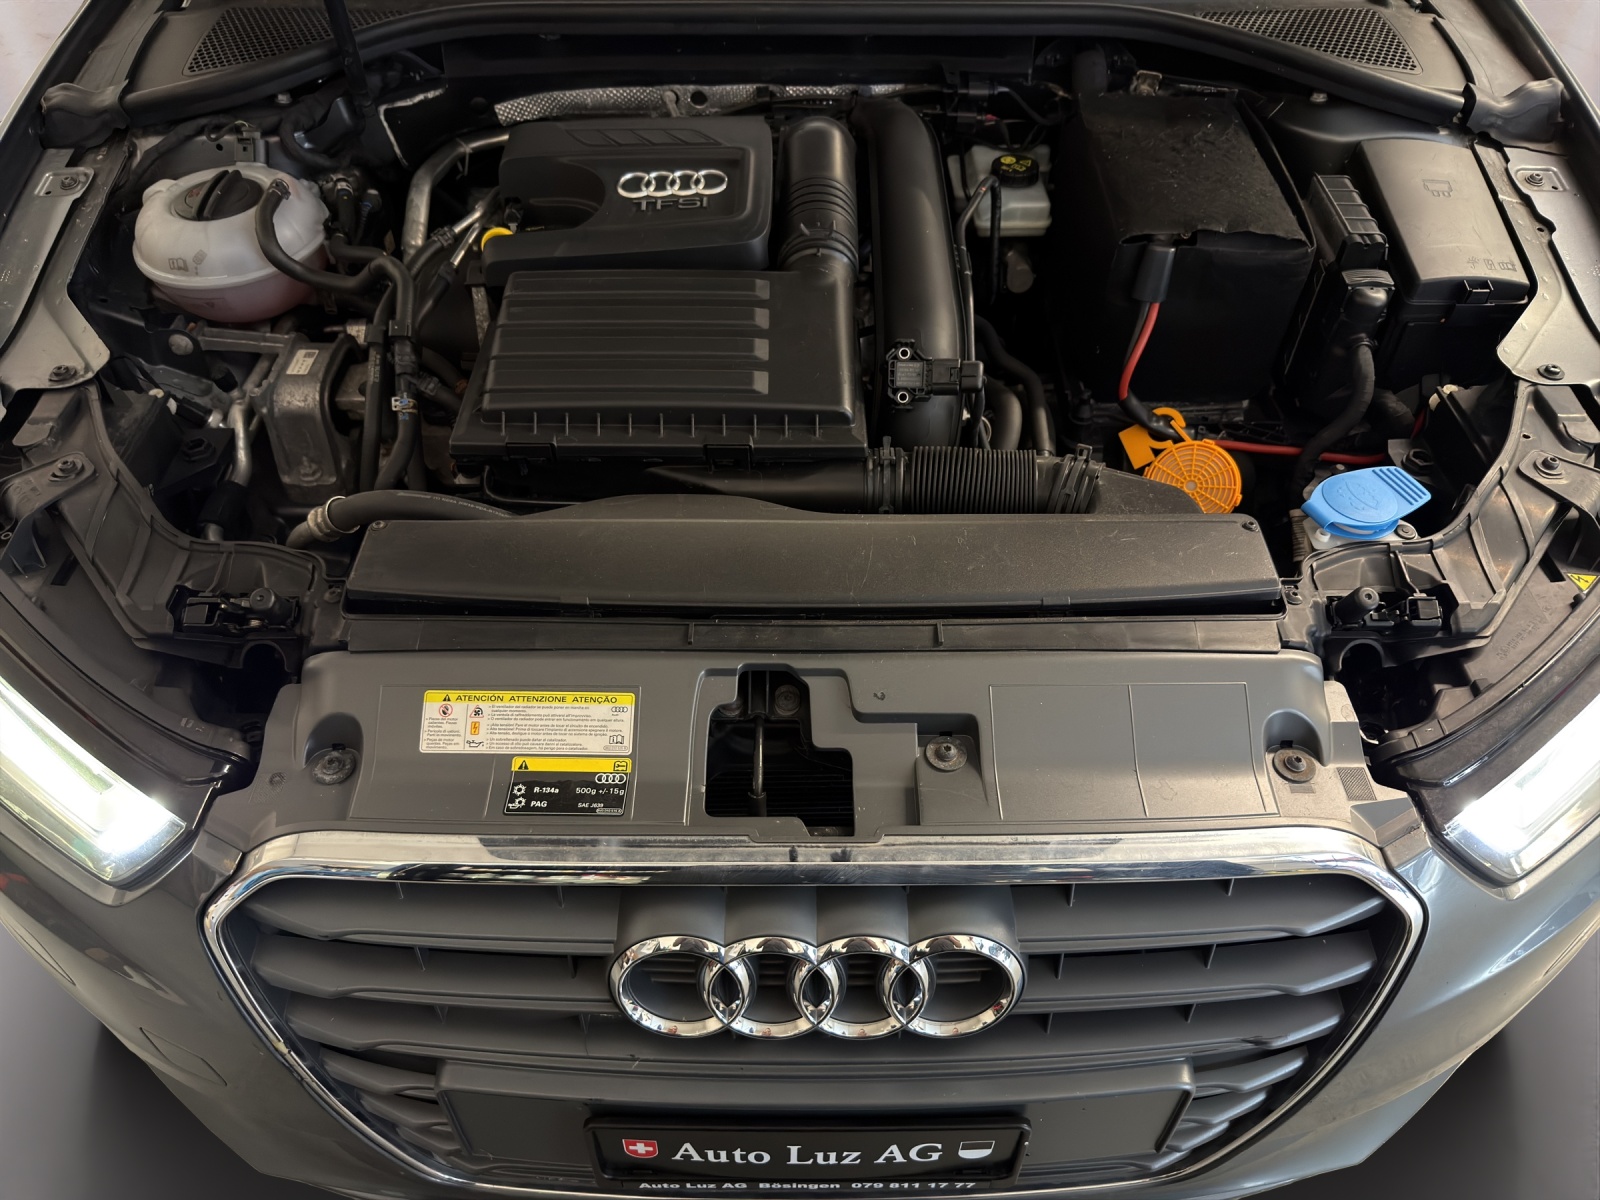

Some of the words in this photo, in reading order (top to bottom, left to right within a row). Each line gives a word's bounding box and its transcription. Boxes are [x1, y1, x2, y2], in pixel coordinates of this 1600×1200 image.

[632, 197, 708, 211] TFSI
[456, 694, 504, 702] ATENCIÓN
[572, 696, 617, 704] ATENÇÃO
[672, 1142, 771, 1164] Auto
[786, 1145, 862, 1165] Luz
[874, 1143, 943, 1164] AG
[759, 1182, 840, 1190] Bösingen
